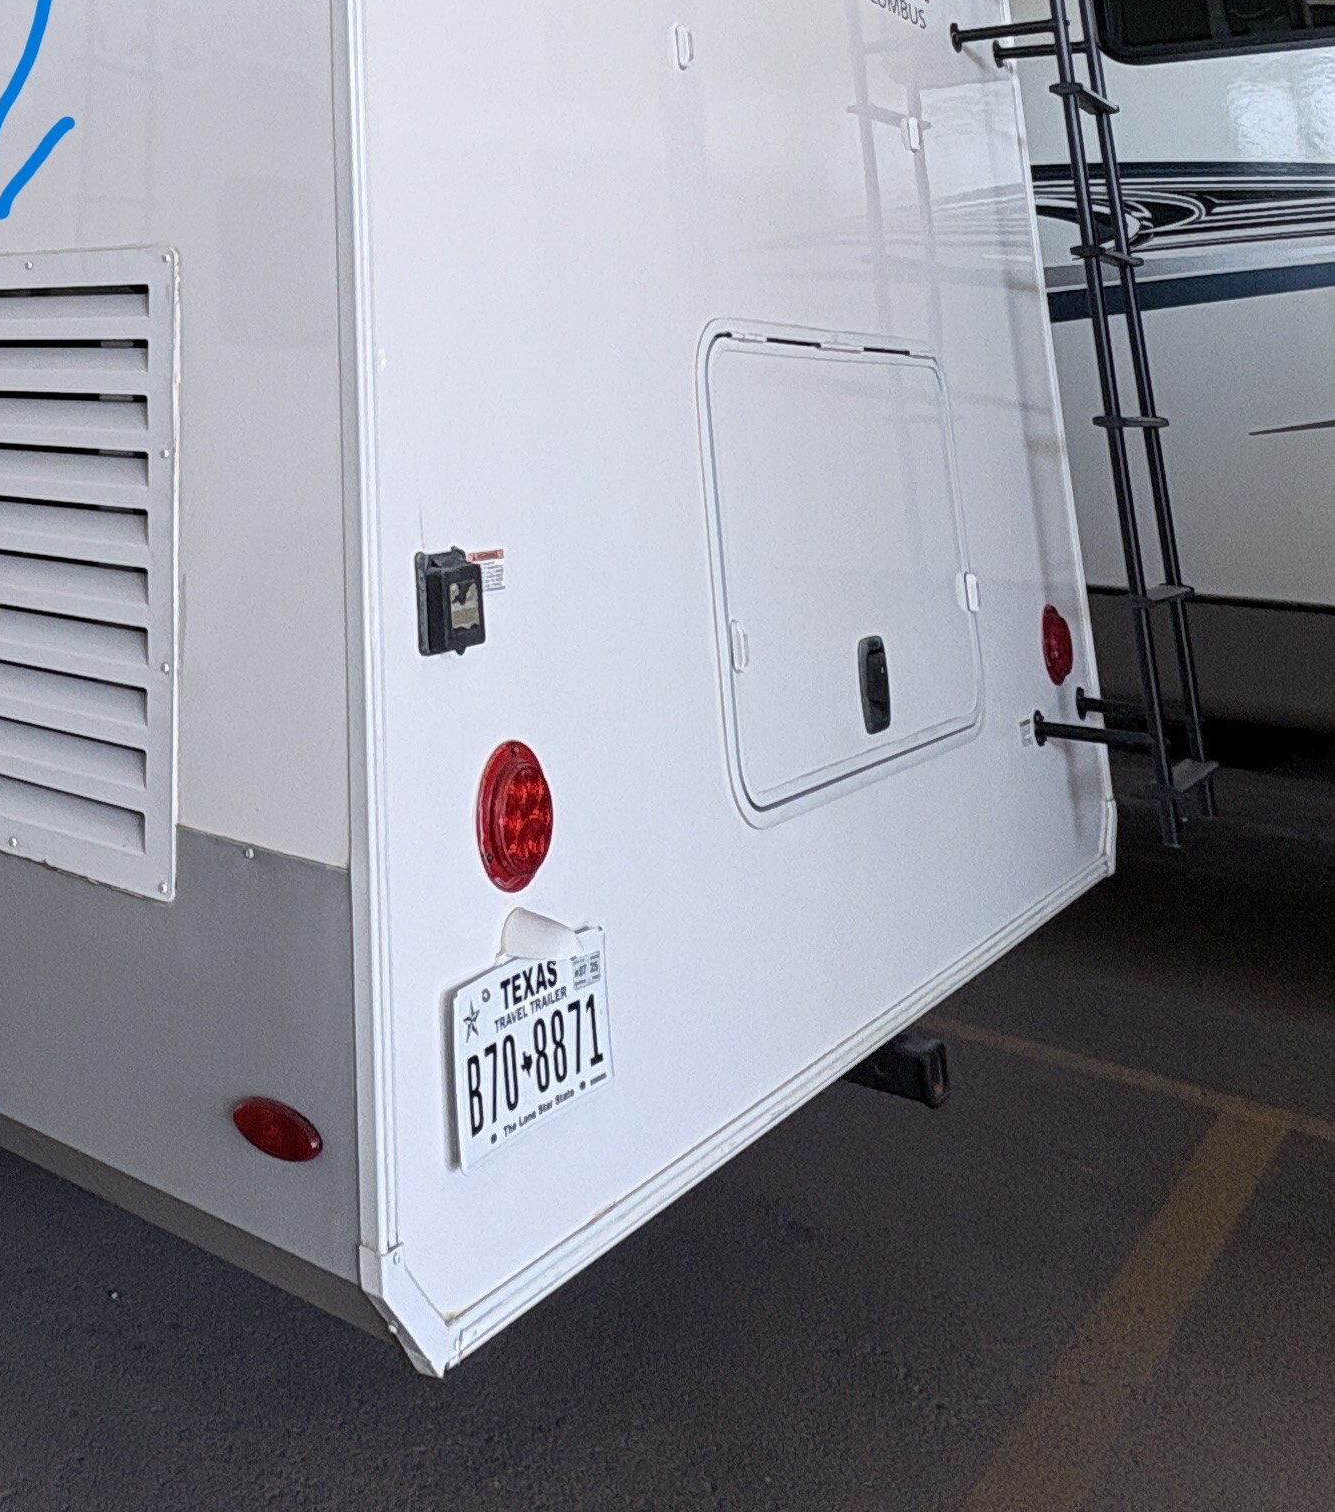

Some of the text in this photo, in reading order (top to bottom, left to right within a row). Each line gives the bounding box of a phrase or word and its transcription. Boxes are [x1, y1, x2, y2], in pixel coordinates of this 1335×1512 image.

[494, 985, 568, 1033] TRAVEL TRAILER
[499, 959, 558, 1011] TEXAS
[503, 1088, 575, 1138] The Lone Star State
